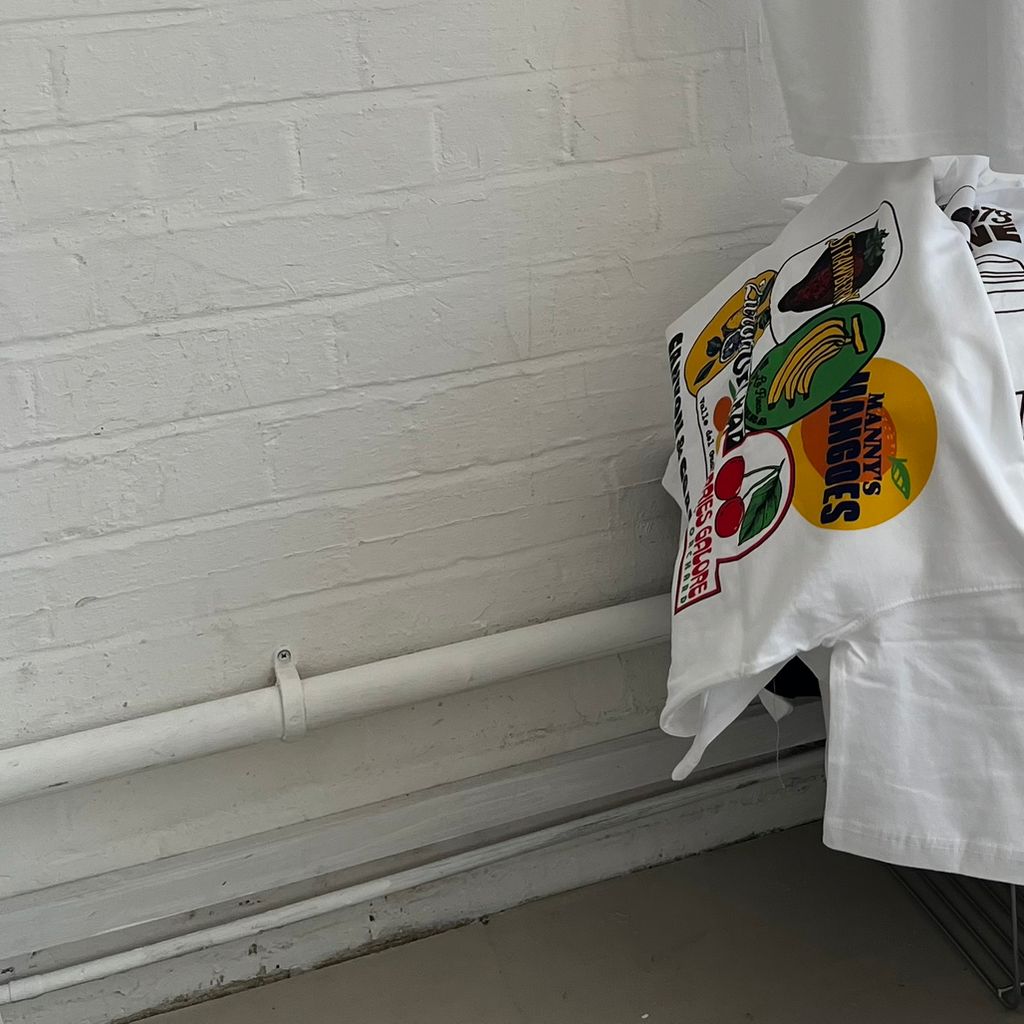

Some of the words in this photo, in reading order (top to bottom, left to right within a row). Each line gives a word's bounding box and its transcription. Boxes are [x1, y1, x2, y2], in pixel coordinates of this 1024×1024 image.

[820, 370, 868, 525] MANGOES
[862, 391, 884, 498] MANNY'S
[680, 527, 695, 604] ORCHARD
[688, 526, 712, 599] GALORE
